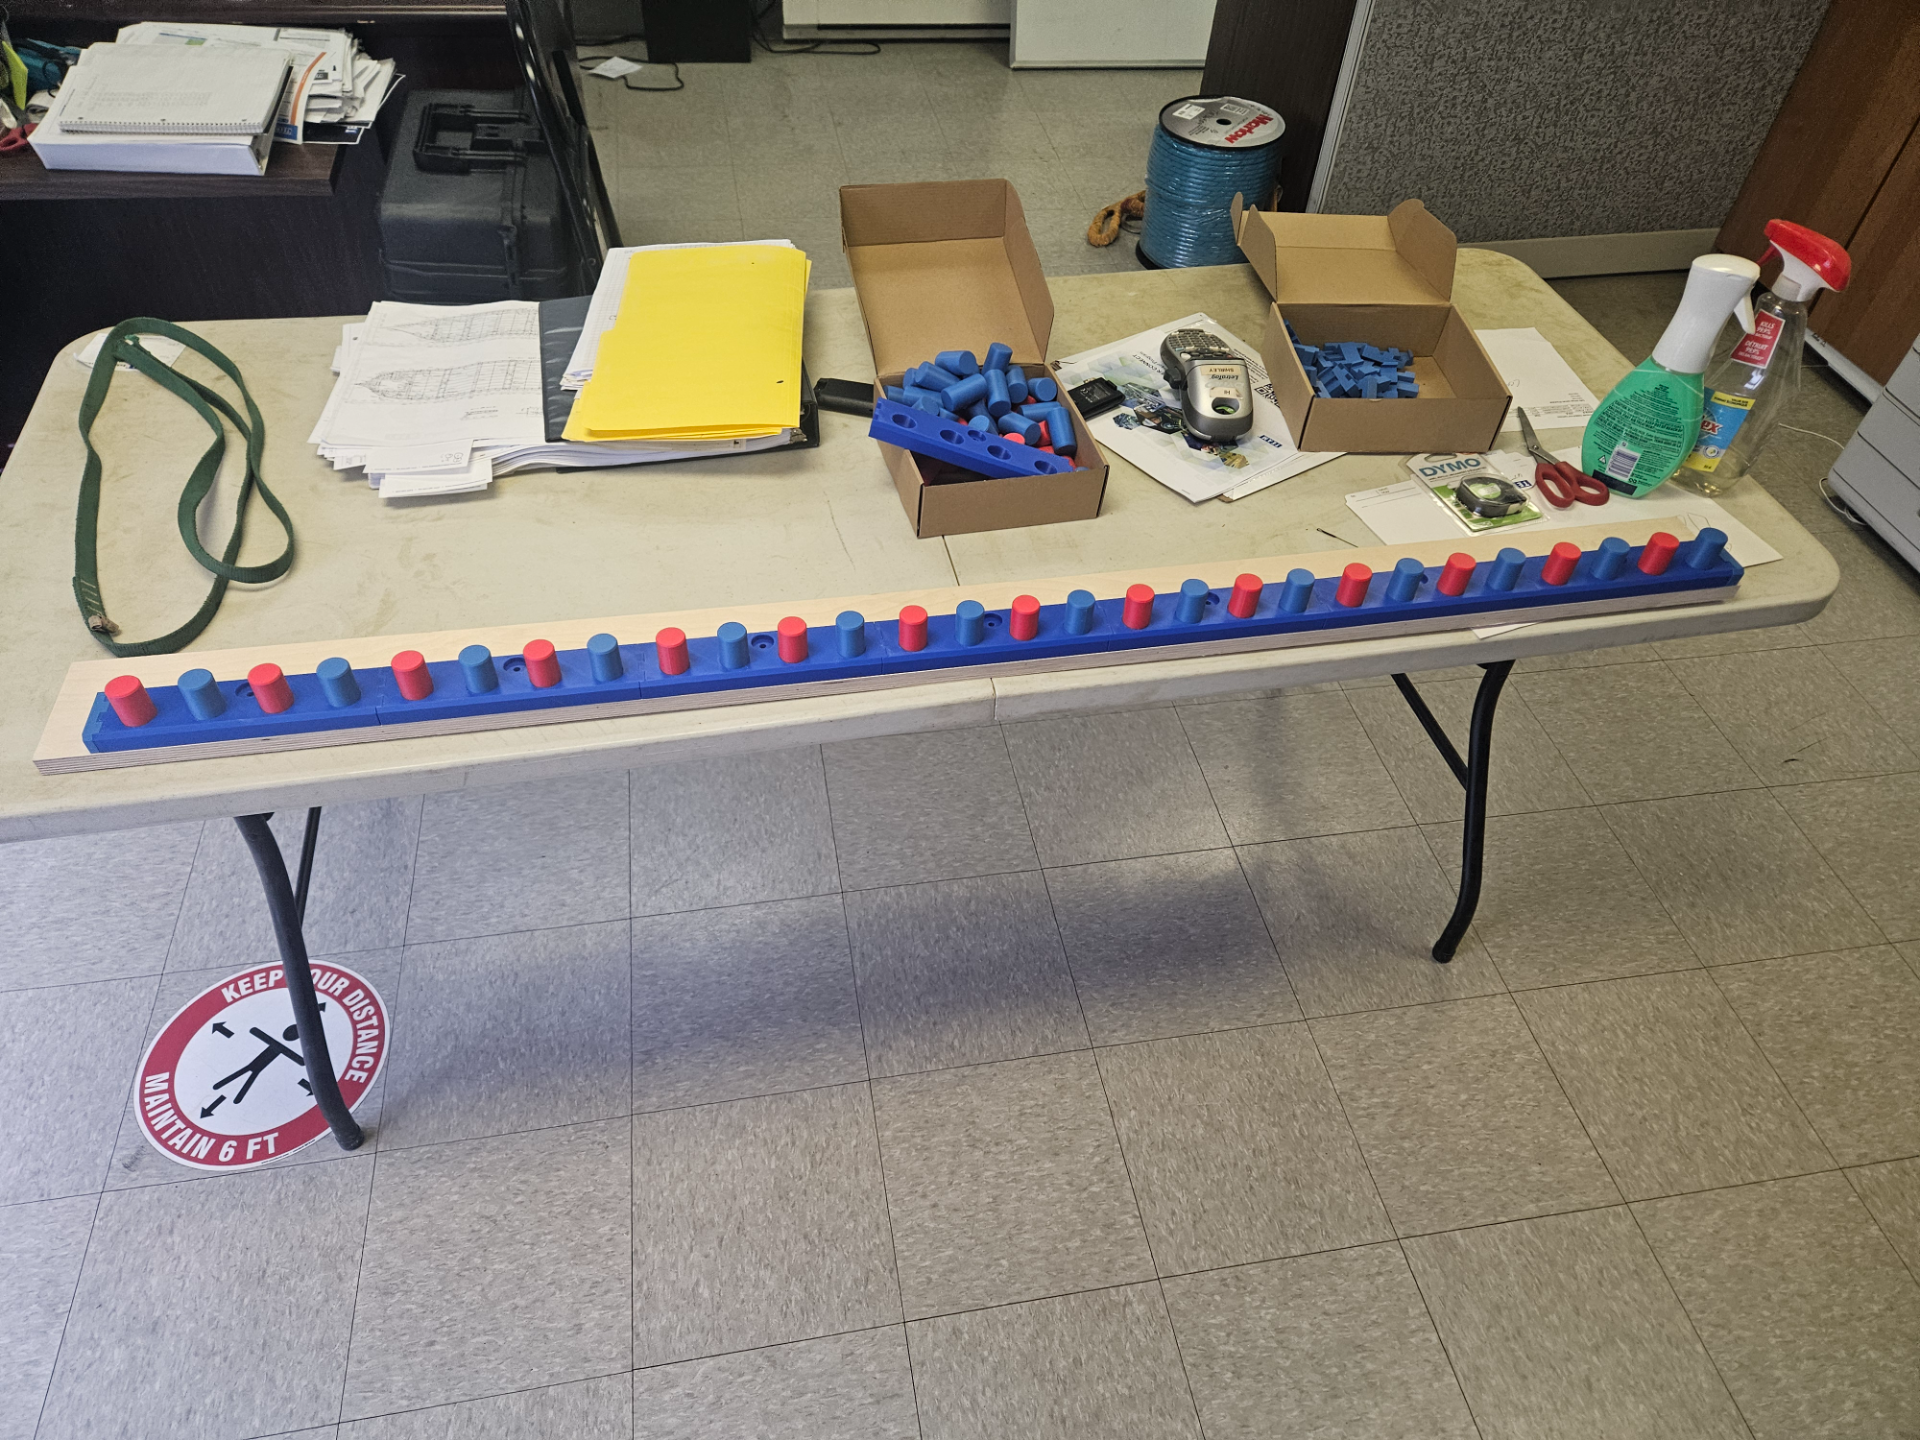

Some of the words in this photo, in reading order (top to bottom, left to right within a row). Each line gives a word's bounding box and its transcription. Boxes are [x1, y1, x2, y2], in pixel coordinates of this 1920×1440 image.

[1419, 458, 1481, 477] DYMO
[221, 969, 285, 1003] KEEP
[309, 968, 350, 997] OUR
[342, 988, 380, 1084] DISTANCE
[143, 1071, 216, 1160] MAINTAIN
[218, 1139, 238, 1162] 6
[245, 1132, 279, 1160] FT
